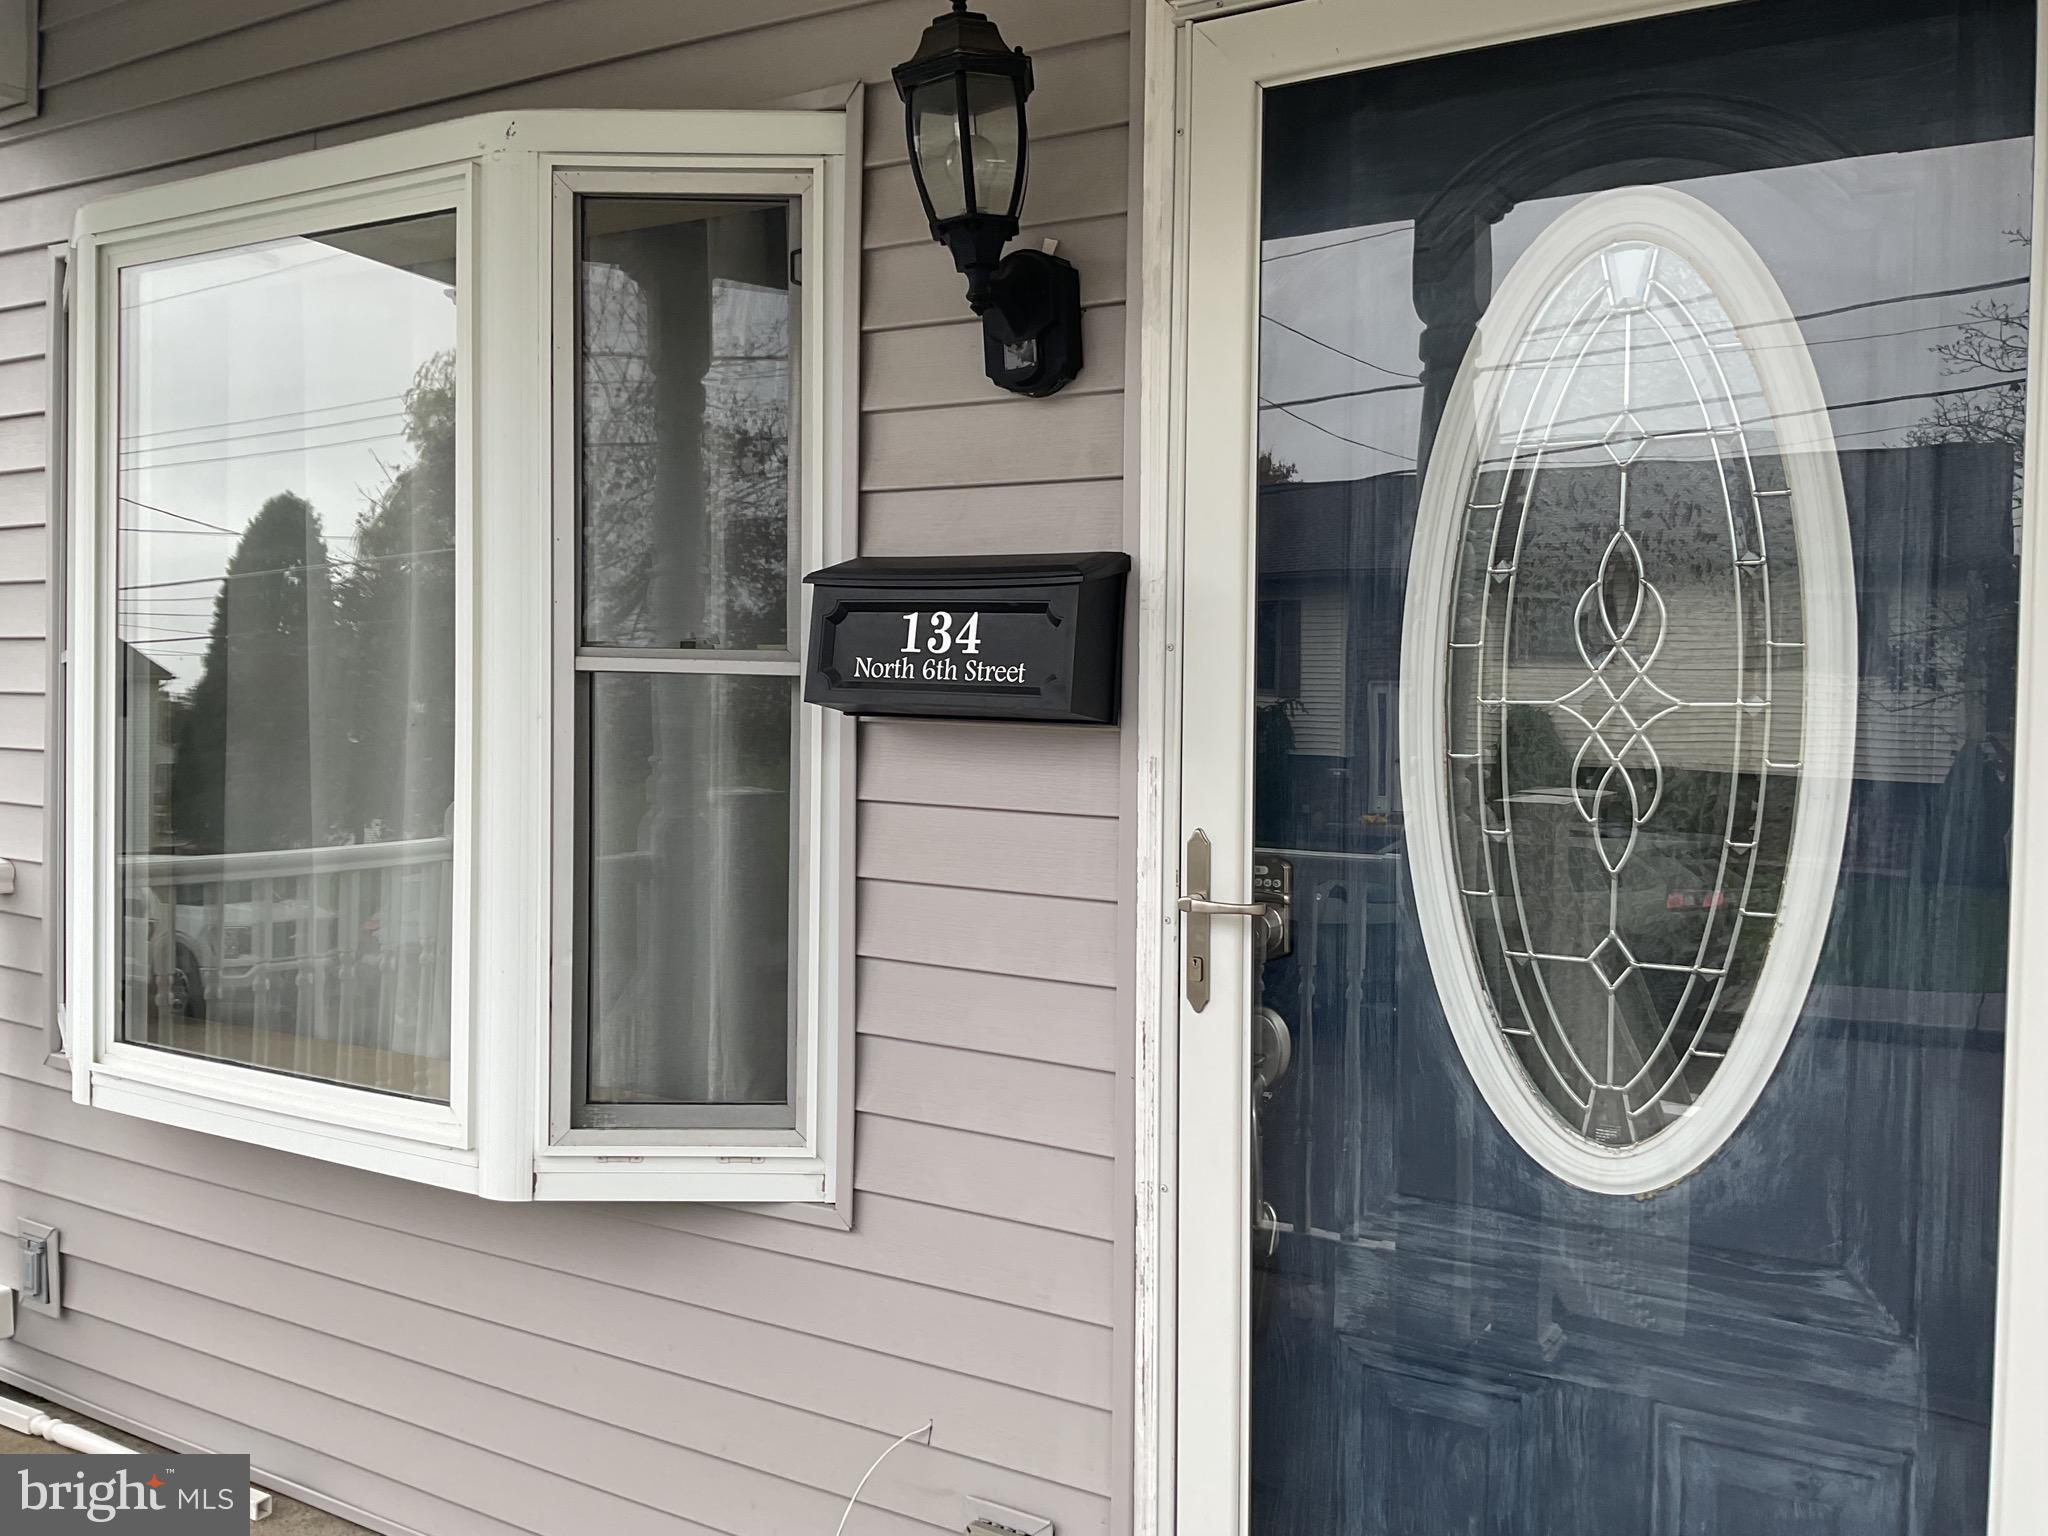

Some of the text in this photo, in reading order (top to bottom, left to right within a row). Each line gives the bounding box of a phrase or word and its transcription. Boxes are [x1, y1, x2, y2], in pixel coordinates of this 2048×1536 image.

[900, 611, 981, 654] 134
[854, 656, 1027, 684] North 6th Street
